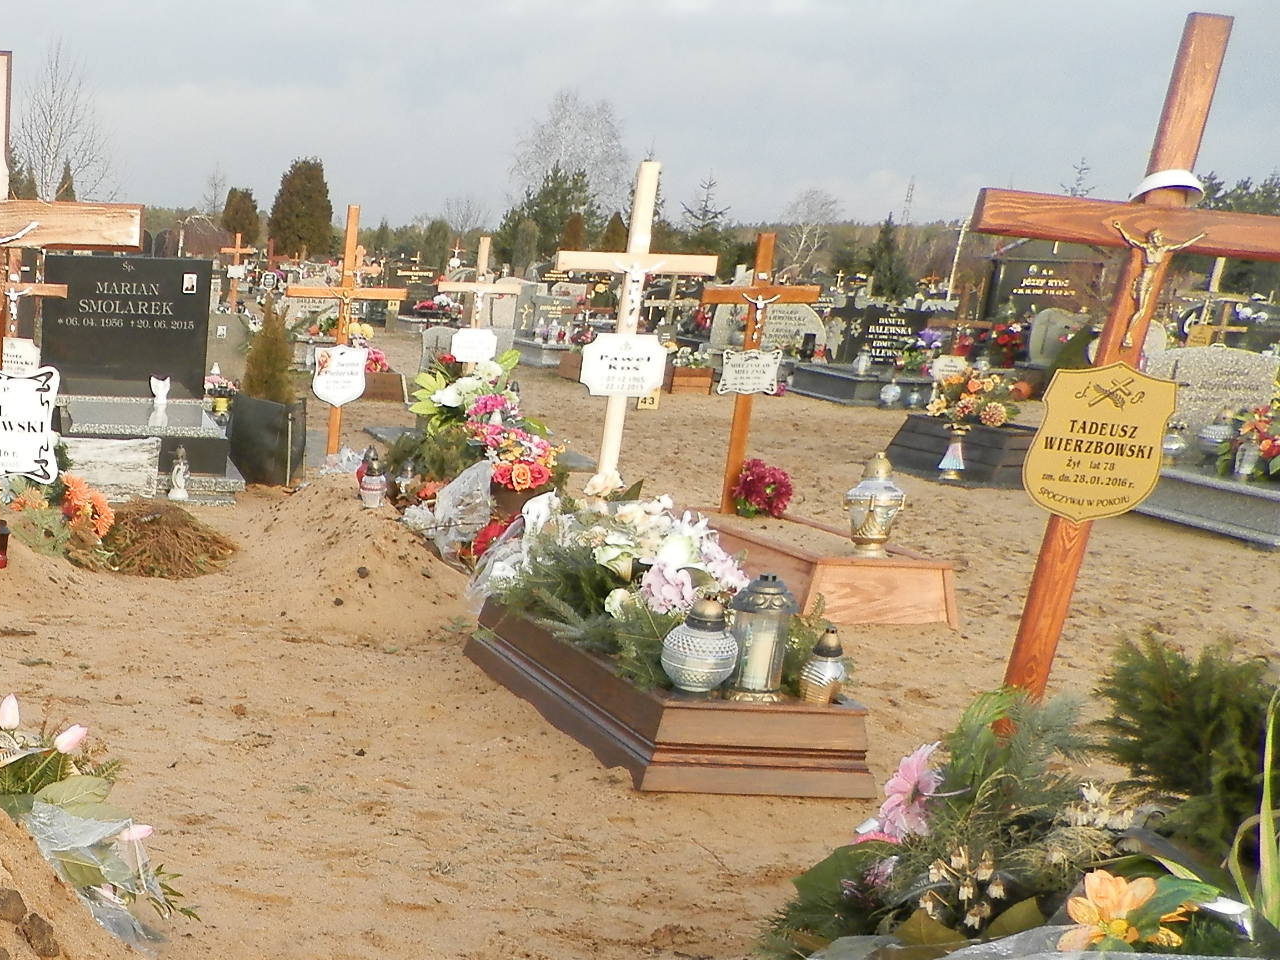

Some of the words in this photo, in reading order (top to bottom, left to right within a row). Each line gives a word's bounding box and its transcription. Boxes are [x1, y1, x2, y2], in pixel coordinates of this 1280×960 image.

[96, 282, 159, 295] MARIAN
[79, 299, 174, 315] SMOLAREK
[640, 397, 655, 405] 43
[1069, 419, 1139, 439] TADEUSZ
[1043, 436, 1154, 460] WIERZBOWSKI
[1089, 460, 1101, 469] lat
[1103, 461, 1116, 471] 78
[1038, 486, 1085, 507] SPOCZYWAJ
[1096, 496, 1131, 508] POKOJU
